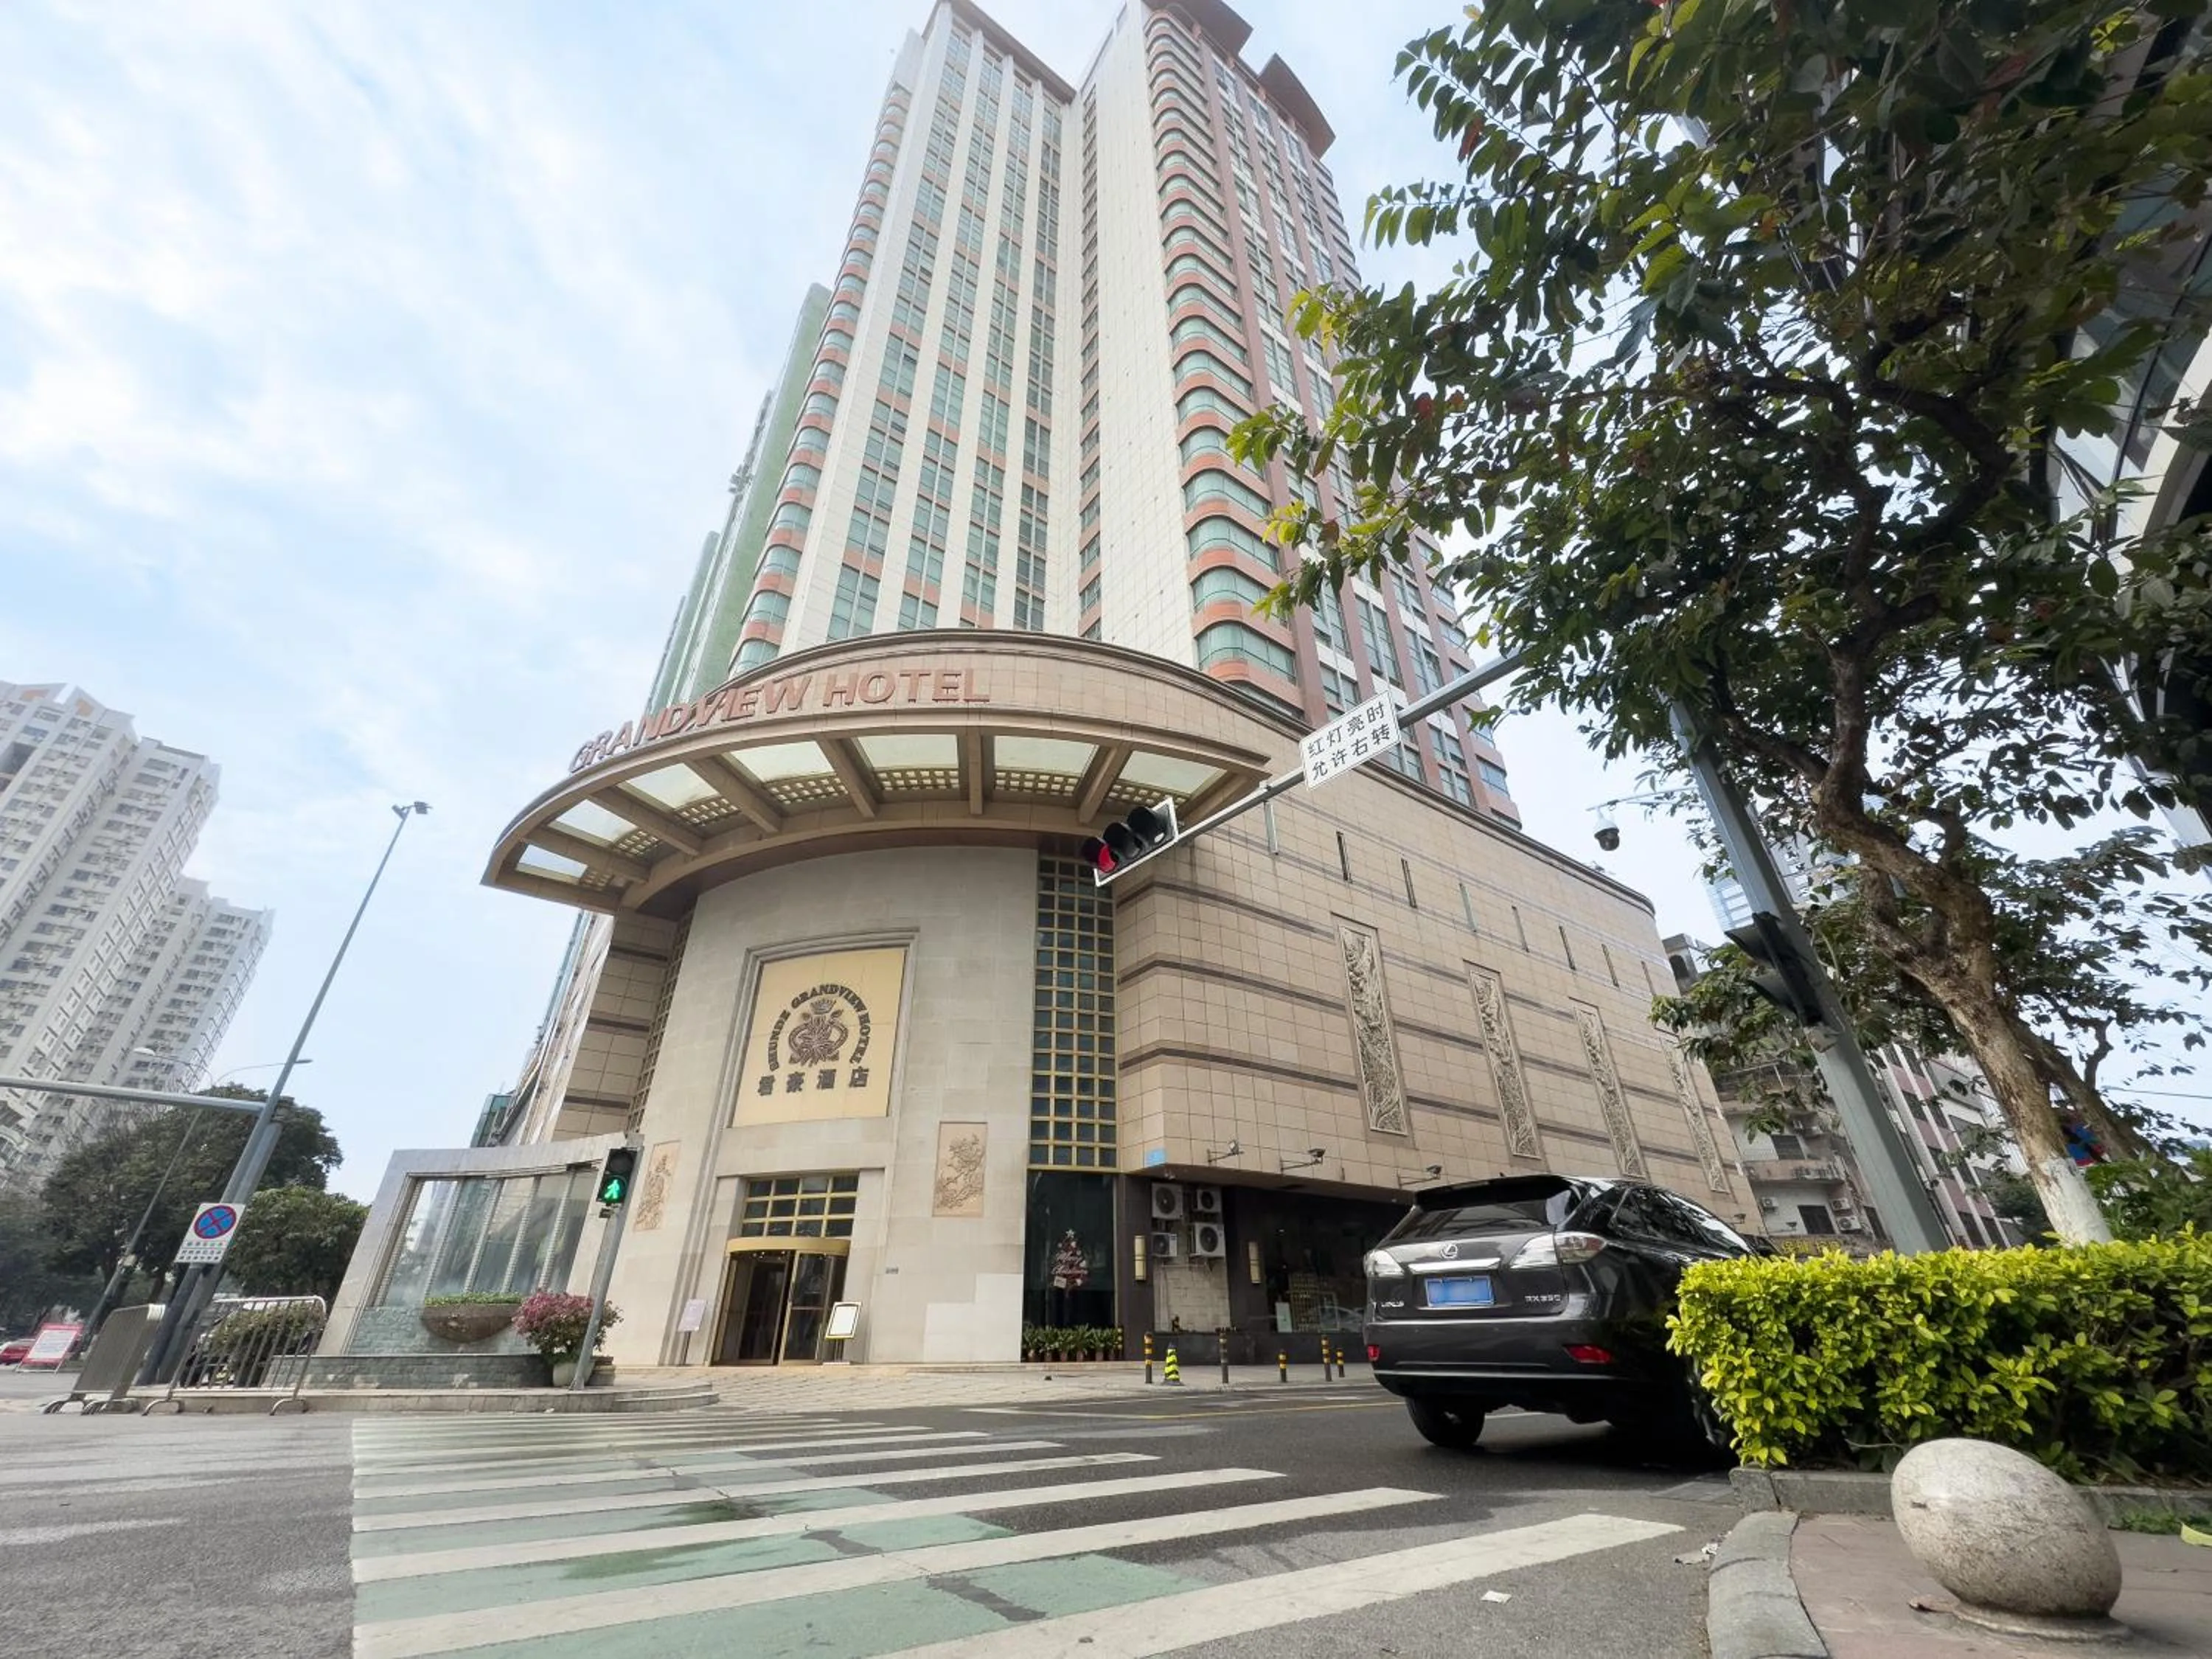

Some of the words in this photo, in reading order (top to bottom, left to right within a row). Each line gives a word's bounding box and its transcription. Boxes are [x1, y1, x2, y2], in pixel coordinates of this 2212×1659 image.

[568, 675, 812, 773] GRANDVIEW
[822, 668, 991, 707] HOTEL
[1307, 701, 1385, 758] 红灯亮时
[1312, 723, 1391, 780] 允许右转
[768, 1009, 791, 1071] SHUNDE
[791, 984, 868, 1012] GRANDVIEW
[849, 1011, 871, 1063] HOTEL
